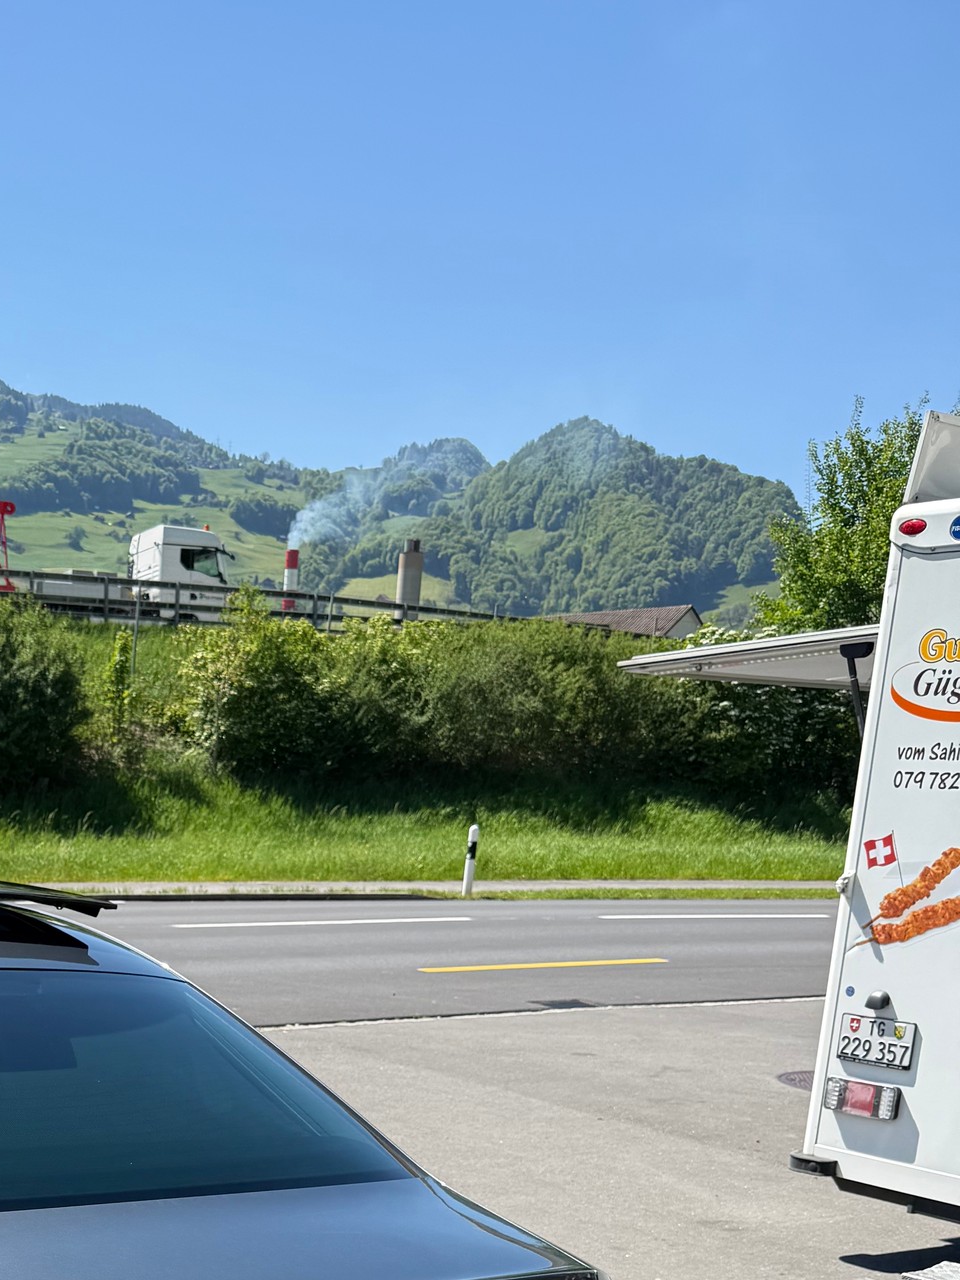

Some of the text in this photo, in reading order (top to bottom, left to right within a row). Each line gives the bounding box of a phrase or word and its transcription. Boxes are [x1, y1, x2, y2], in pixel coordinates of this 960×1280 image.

[897, 746, 925, 760] vom
[893, 770, 925, 789] 079
[869, 1020, 885, 1037] TG
[840, 1035, 872, 1059] 229
[875, 1041, 910, 1066] 357
